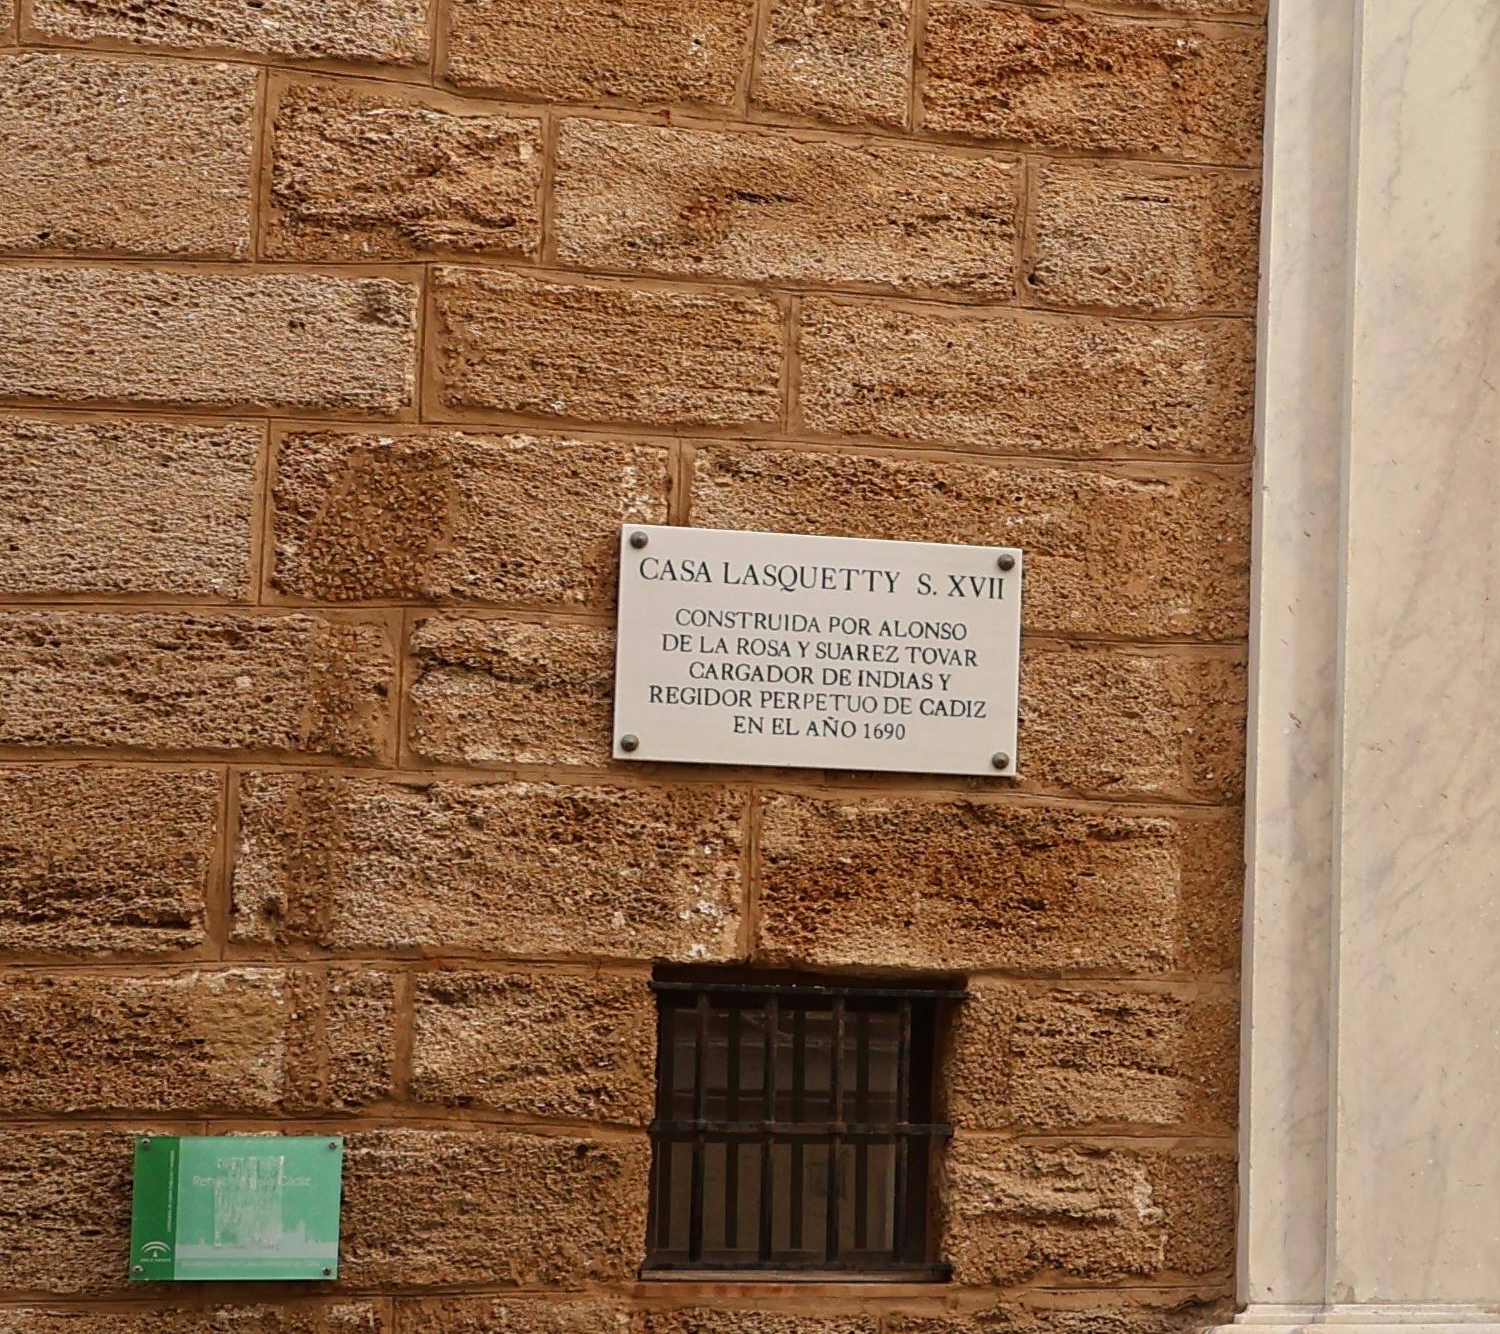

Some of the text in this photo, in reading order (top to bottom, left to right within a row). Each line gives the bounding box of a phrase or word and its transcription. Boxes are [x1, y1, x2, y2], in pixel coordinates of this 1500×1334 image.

[639, 556, 1005, 601] CASA LASQUETTY S. XVII
[675, 608, 968, 642] CONSTRUIDA POR ALONSO
[661, 633, 979, 668] DE LA ROSA Y SUAREZ TOVAR
[688, 660, 952, 692] CARGADOR DE INDIAS Y
[648, 684, 987, 719] REGIDOR PERPETUO DE CADIZ
[732, 714, 906, 741] EN EL AÑO 1690
